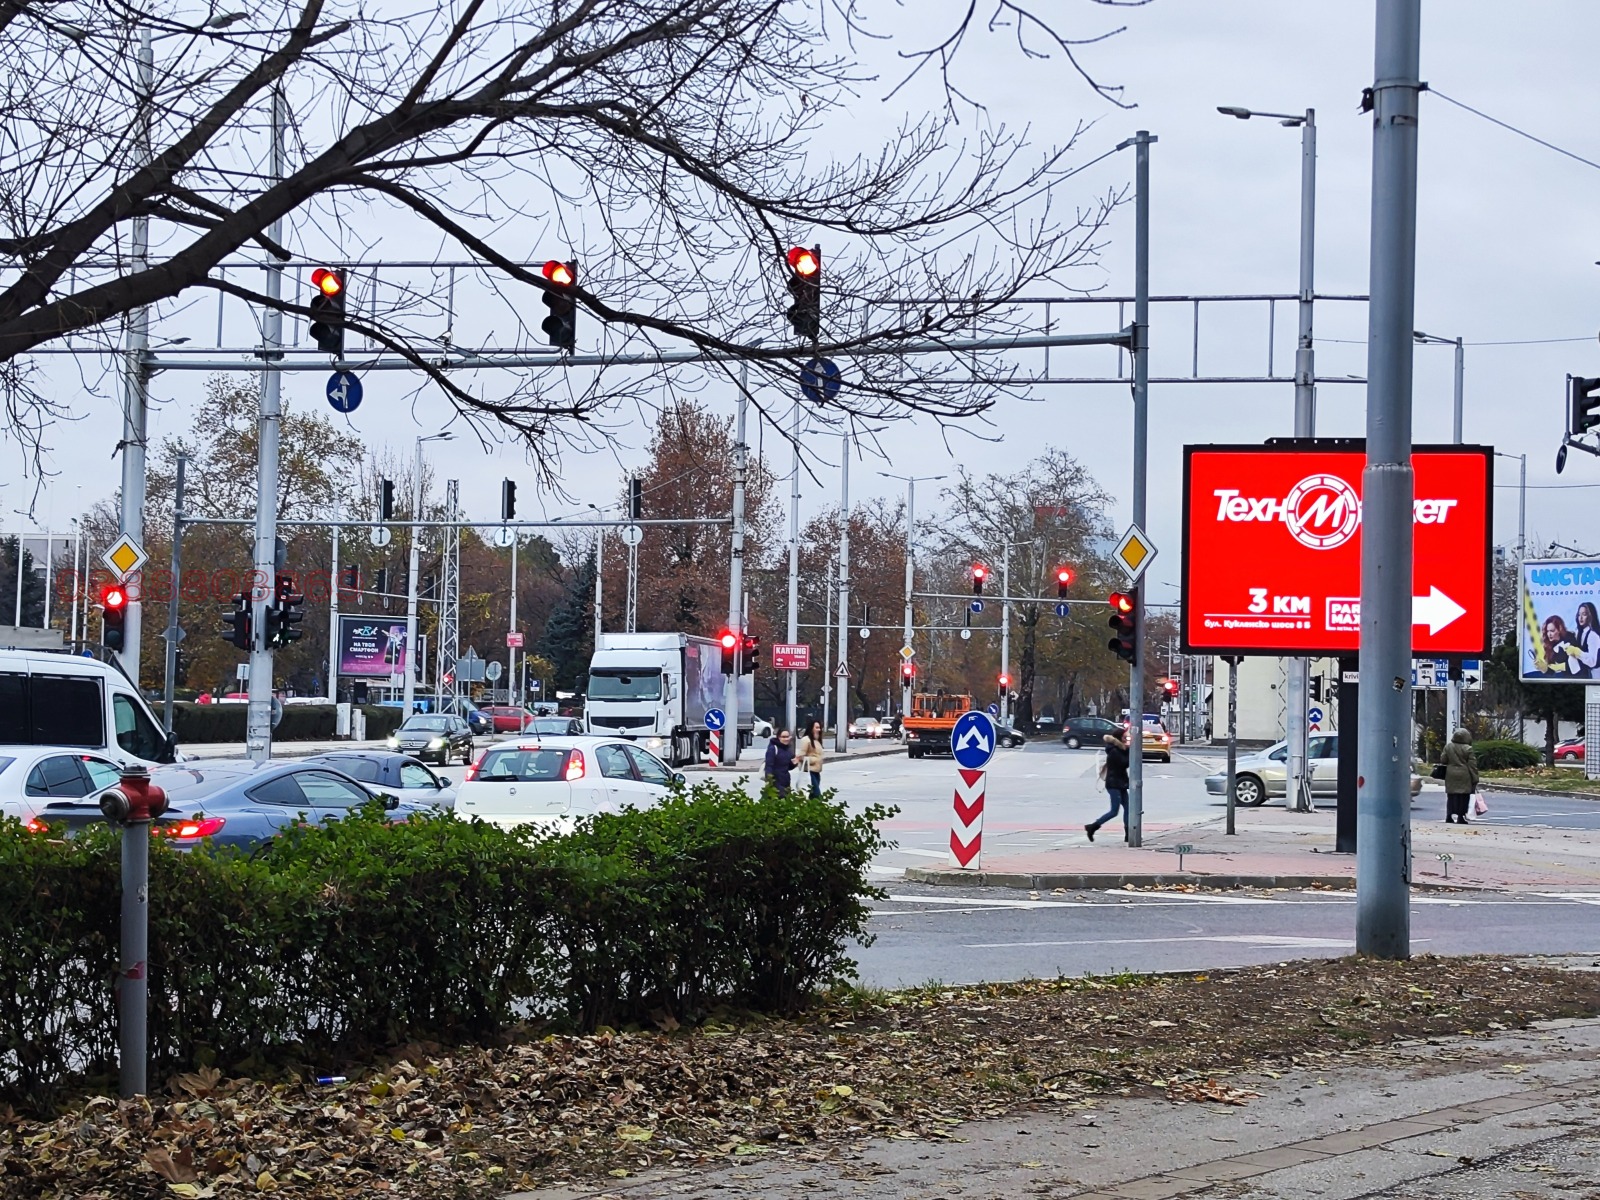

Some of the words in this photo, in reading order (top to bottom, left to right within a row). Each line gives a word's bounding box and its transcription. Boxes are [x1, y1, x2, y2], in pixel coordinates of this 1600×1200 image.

[1531, 589, 1594, 597] ПРОФЕСИОНАЛНО
[1248, 588, 1268, 613] 3
[1331, 603, 1361, 613] PAR
[1204, 619, 1222, 629] бул.
[1271, 621, 1295, 629] шосе
[776, 647, 806, 655] KARTING
